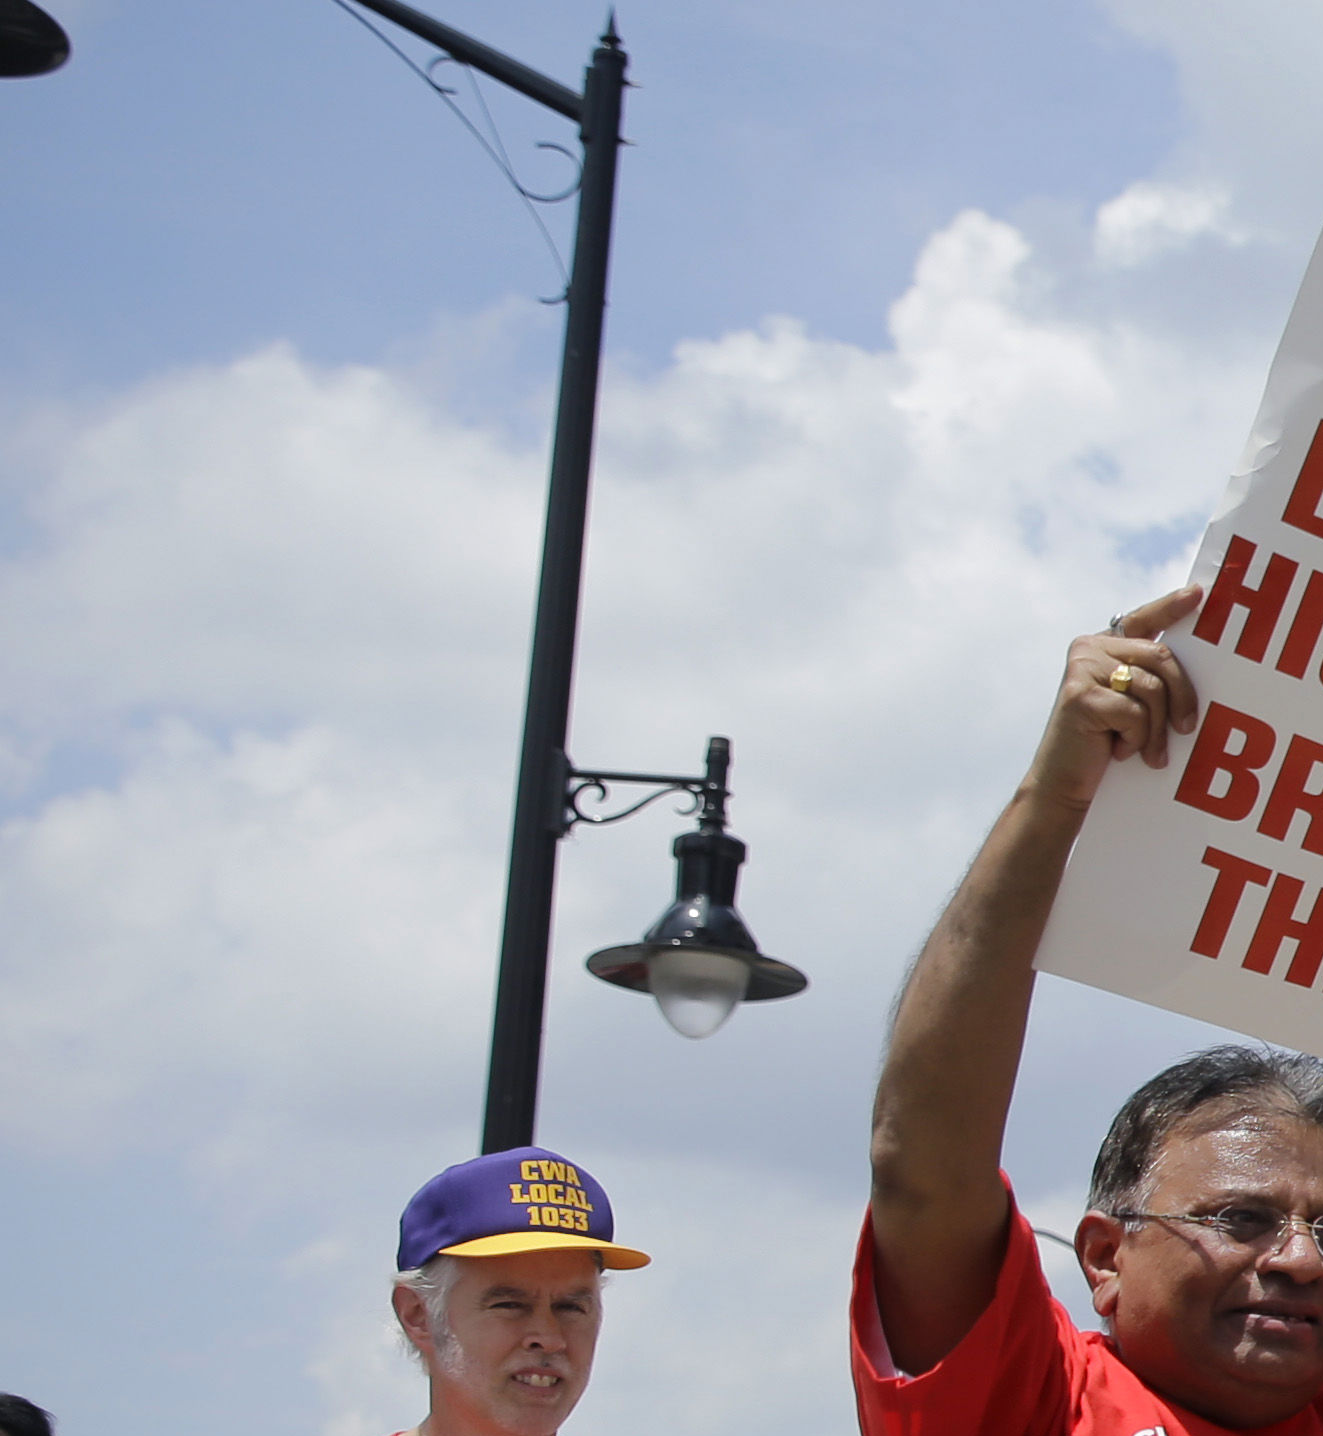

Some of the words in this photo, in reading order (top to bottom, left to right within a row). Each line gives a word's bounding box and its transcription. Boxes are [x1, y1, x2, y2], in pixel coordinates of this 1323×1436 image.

[520, 1160, 582, 1187] CWA
[509, 1183, 594, 1212] LOCAL
[526, 1206, 589, 1231] 1033
